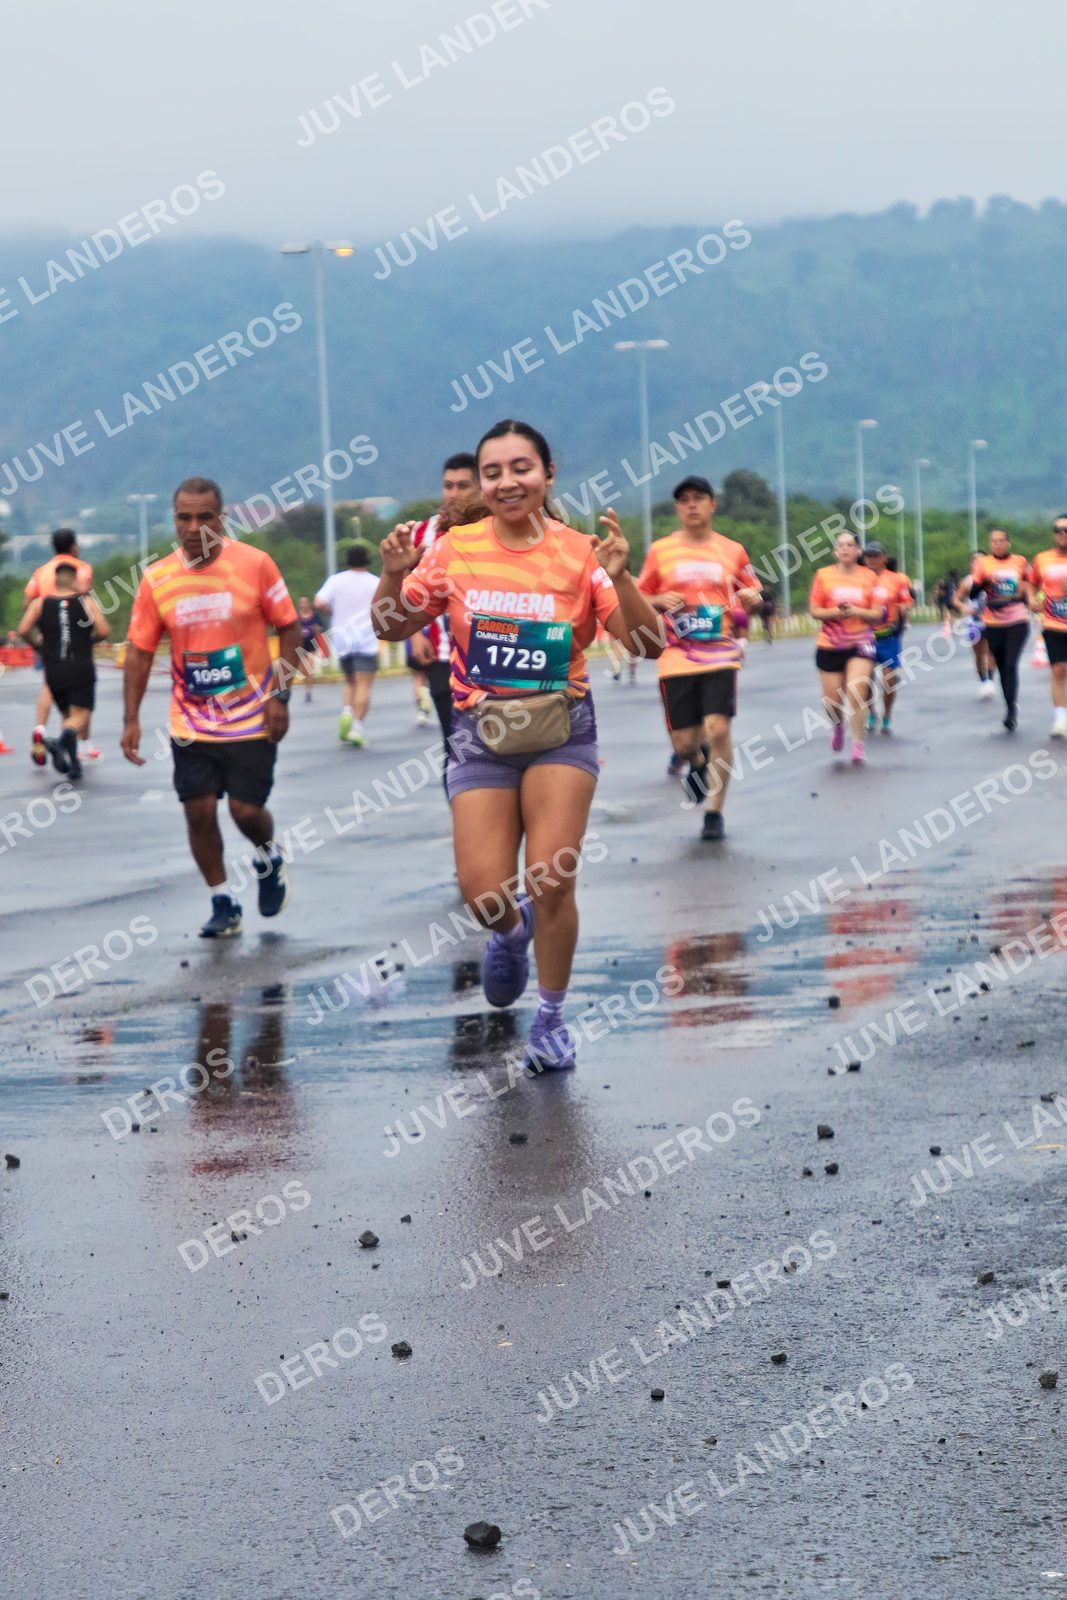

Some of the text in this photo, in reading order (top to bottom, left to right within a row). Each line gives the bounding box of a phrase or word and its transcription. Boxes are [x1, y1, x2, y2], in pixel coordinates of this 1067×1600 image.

[464, 589, 556, 614] CARRERA
[476, 619, 520, 636] CARRERA
[546, 626, 566, 641] 10K
[486, 645, 547, 670] 1729
[192, 665, 232, 685] 1096
